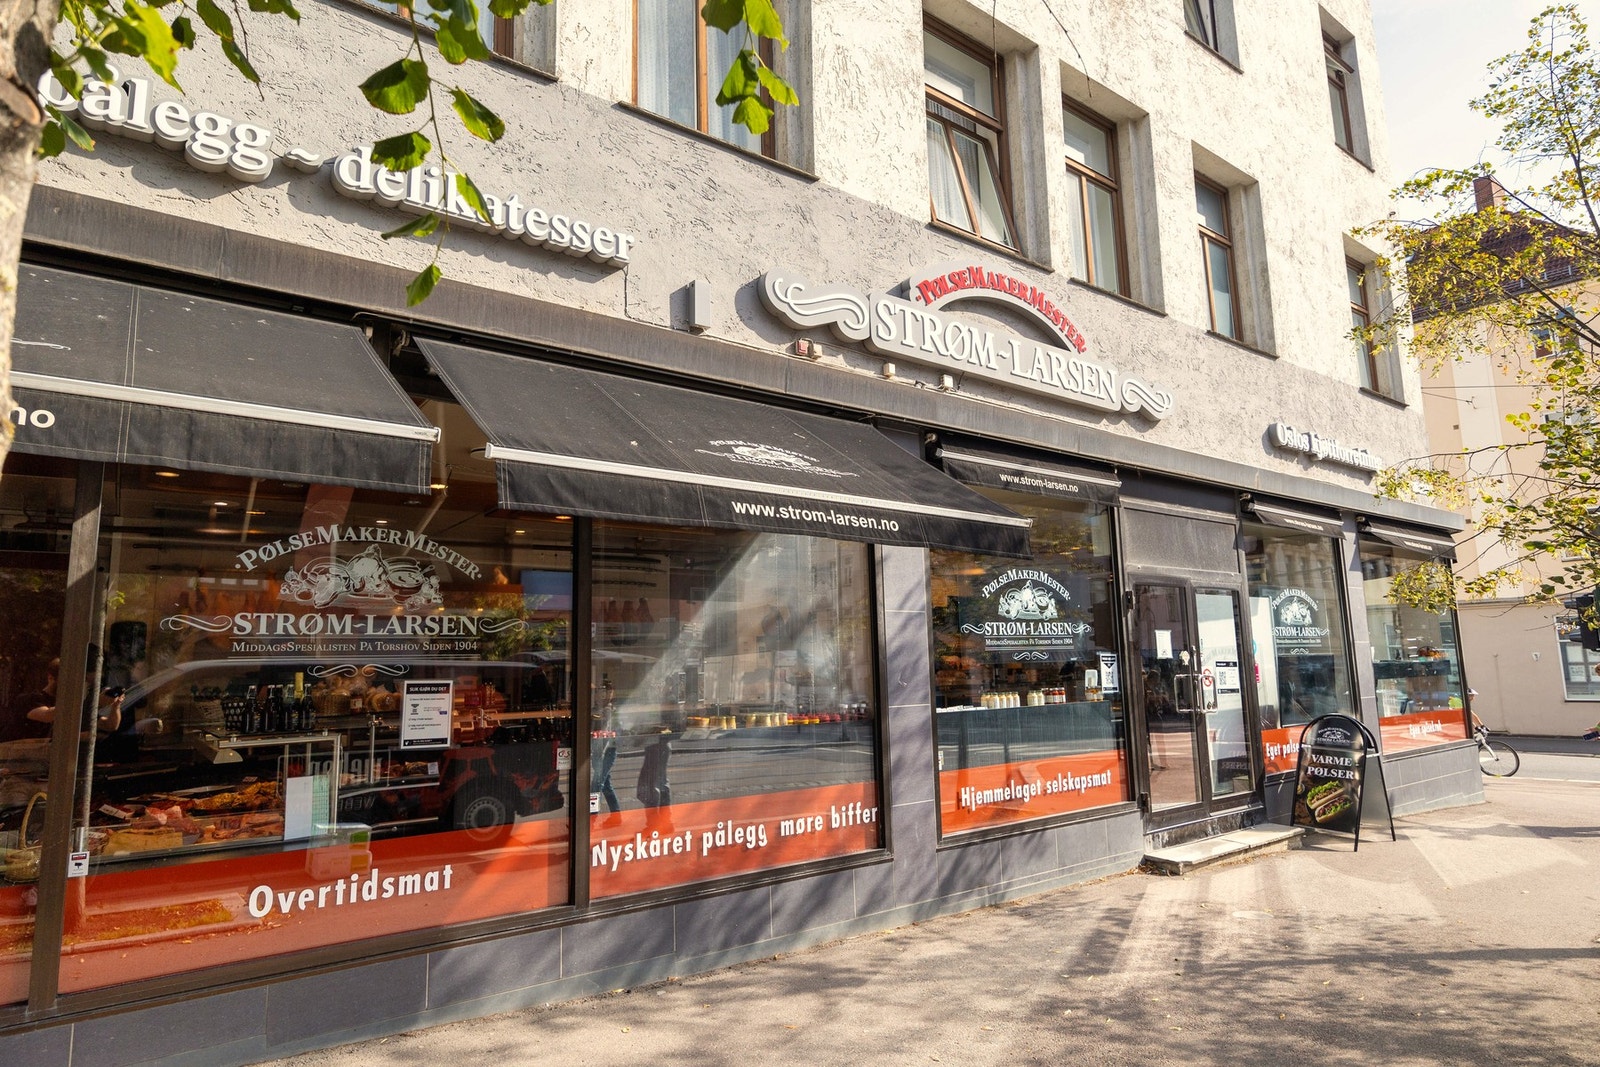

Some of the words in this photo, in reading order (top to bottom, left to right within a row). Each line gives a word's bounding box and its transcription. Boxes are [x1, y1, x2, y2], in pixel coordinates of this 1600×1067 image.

[338, 146, 634, 260] delikatesser
[876, 300, 1118, 404] STRØM-LARSEN
[1278, 423, 1311, 452] Oslos
[999, 474, 1079, 493] www.strom-larsen.no
[731, 501, 899, 532] www.strom-larsen.no
[233, 612, 478, 637] STRØM-LARSEN
[984, 621, 1073, 636] STRØM-LARSEN
[454, 641, 478, 651] 1904
[1307, 766, 1354, 779] PØLSER
[1311, 754, 1353, 767] VARME
[961, 779, 1042, 811] Hjemmelaget
[1046, 769, 1112, 793] selskapsmat
[592, 831, 693, 871] Nyskåret
[702, 820, 768, 856] pålegg
[780, 813, 823, 837] møre
[831, 801, 878, 829] biffer
[248, 863, 454, 919] Overtidsmat
